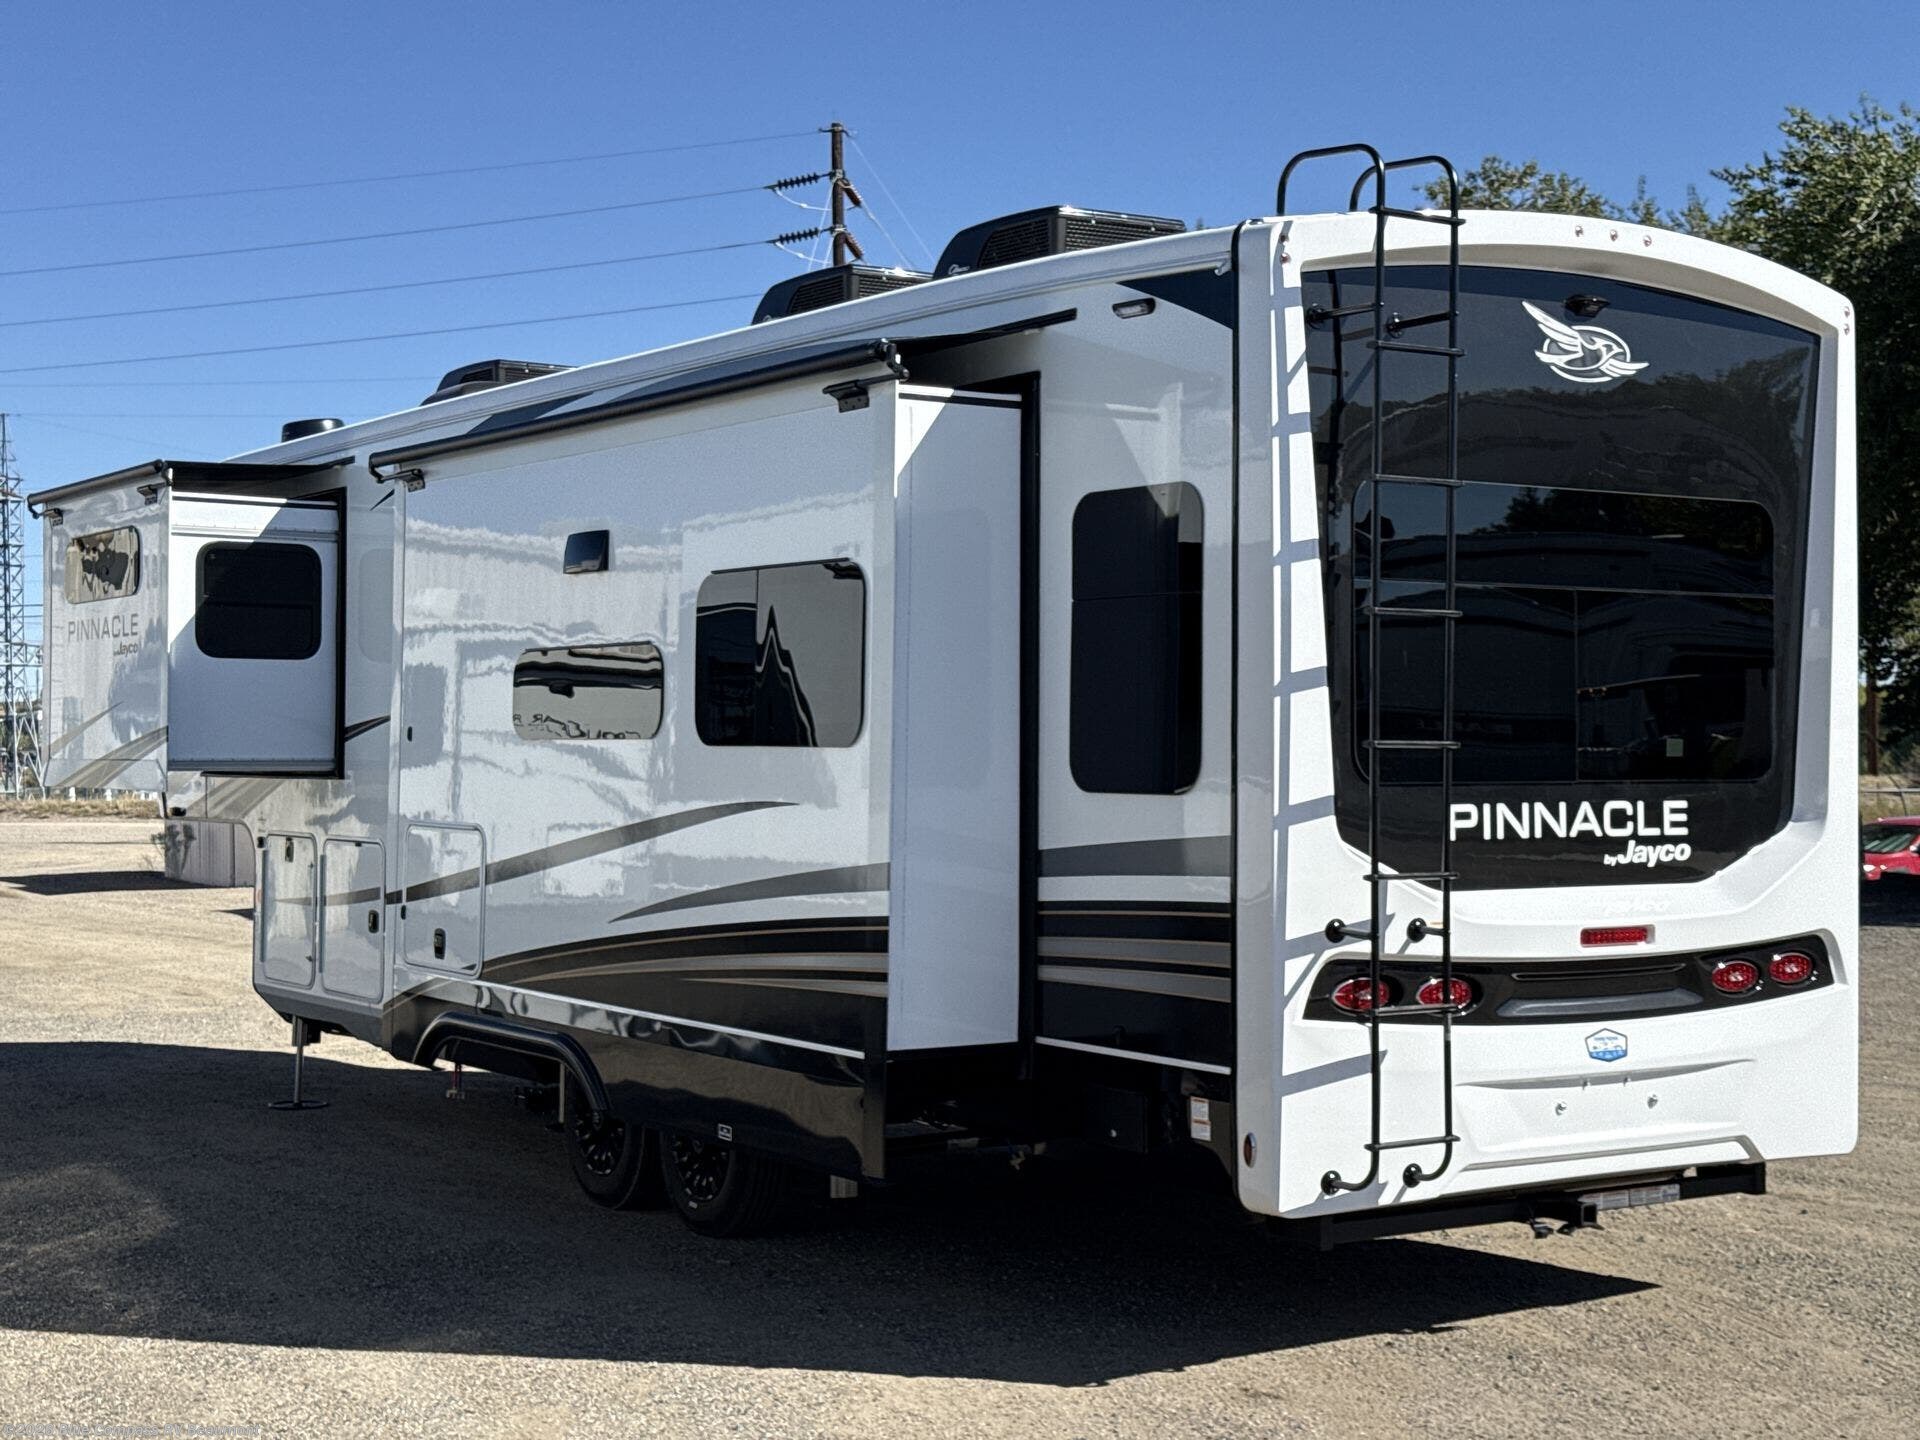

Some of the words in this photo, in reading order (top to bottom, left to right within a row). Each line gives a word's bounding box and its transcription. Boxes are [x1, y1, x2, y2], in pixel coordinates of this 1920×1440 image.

[68, 613, 139, 641] PINNACLE
[1449, 800, 1689, 841] PINNACLE
[1617, 840, 1691, 867] Jayco
